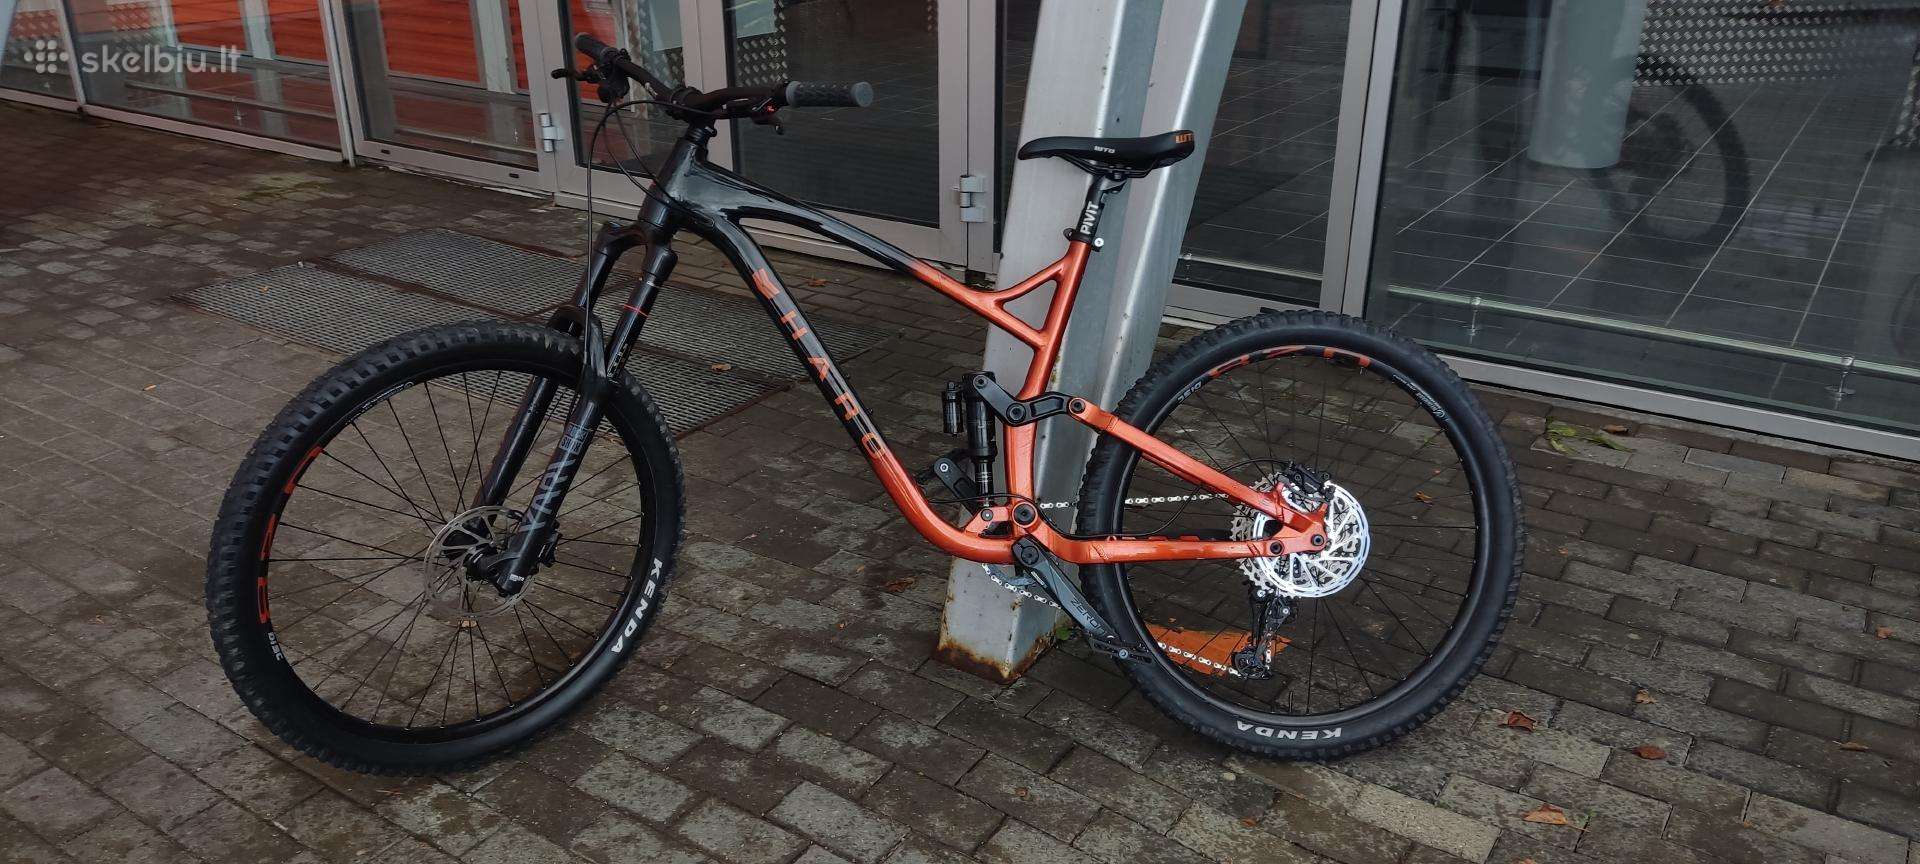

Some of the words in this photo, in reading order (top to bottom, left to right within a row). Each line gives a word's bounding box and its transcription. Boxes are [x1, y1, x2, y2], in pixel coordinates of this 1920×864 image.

[1080, 201, 1099, 235] PIVIT
[780, 309, 886, 459] HARO
[611, 558, 663, 653] KENDA
[1237, 720, 1342, 740] KENDA
